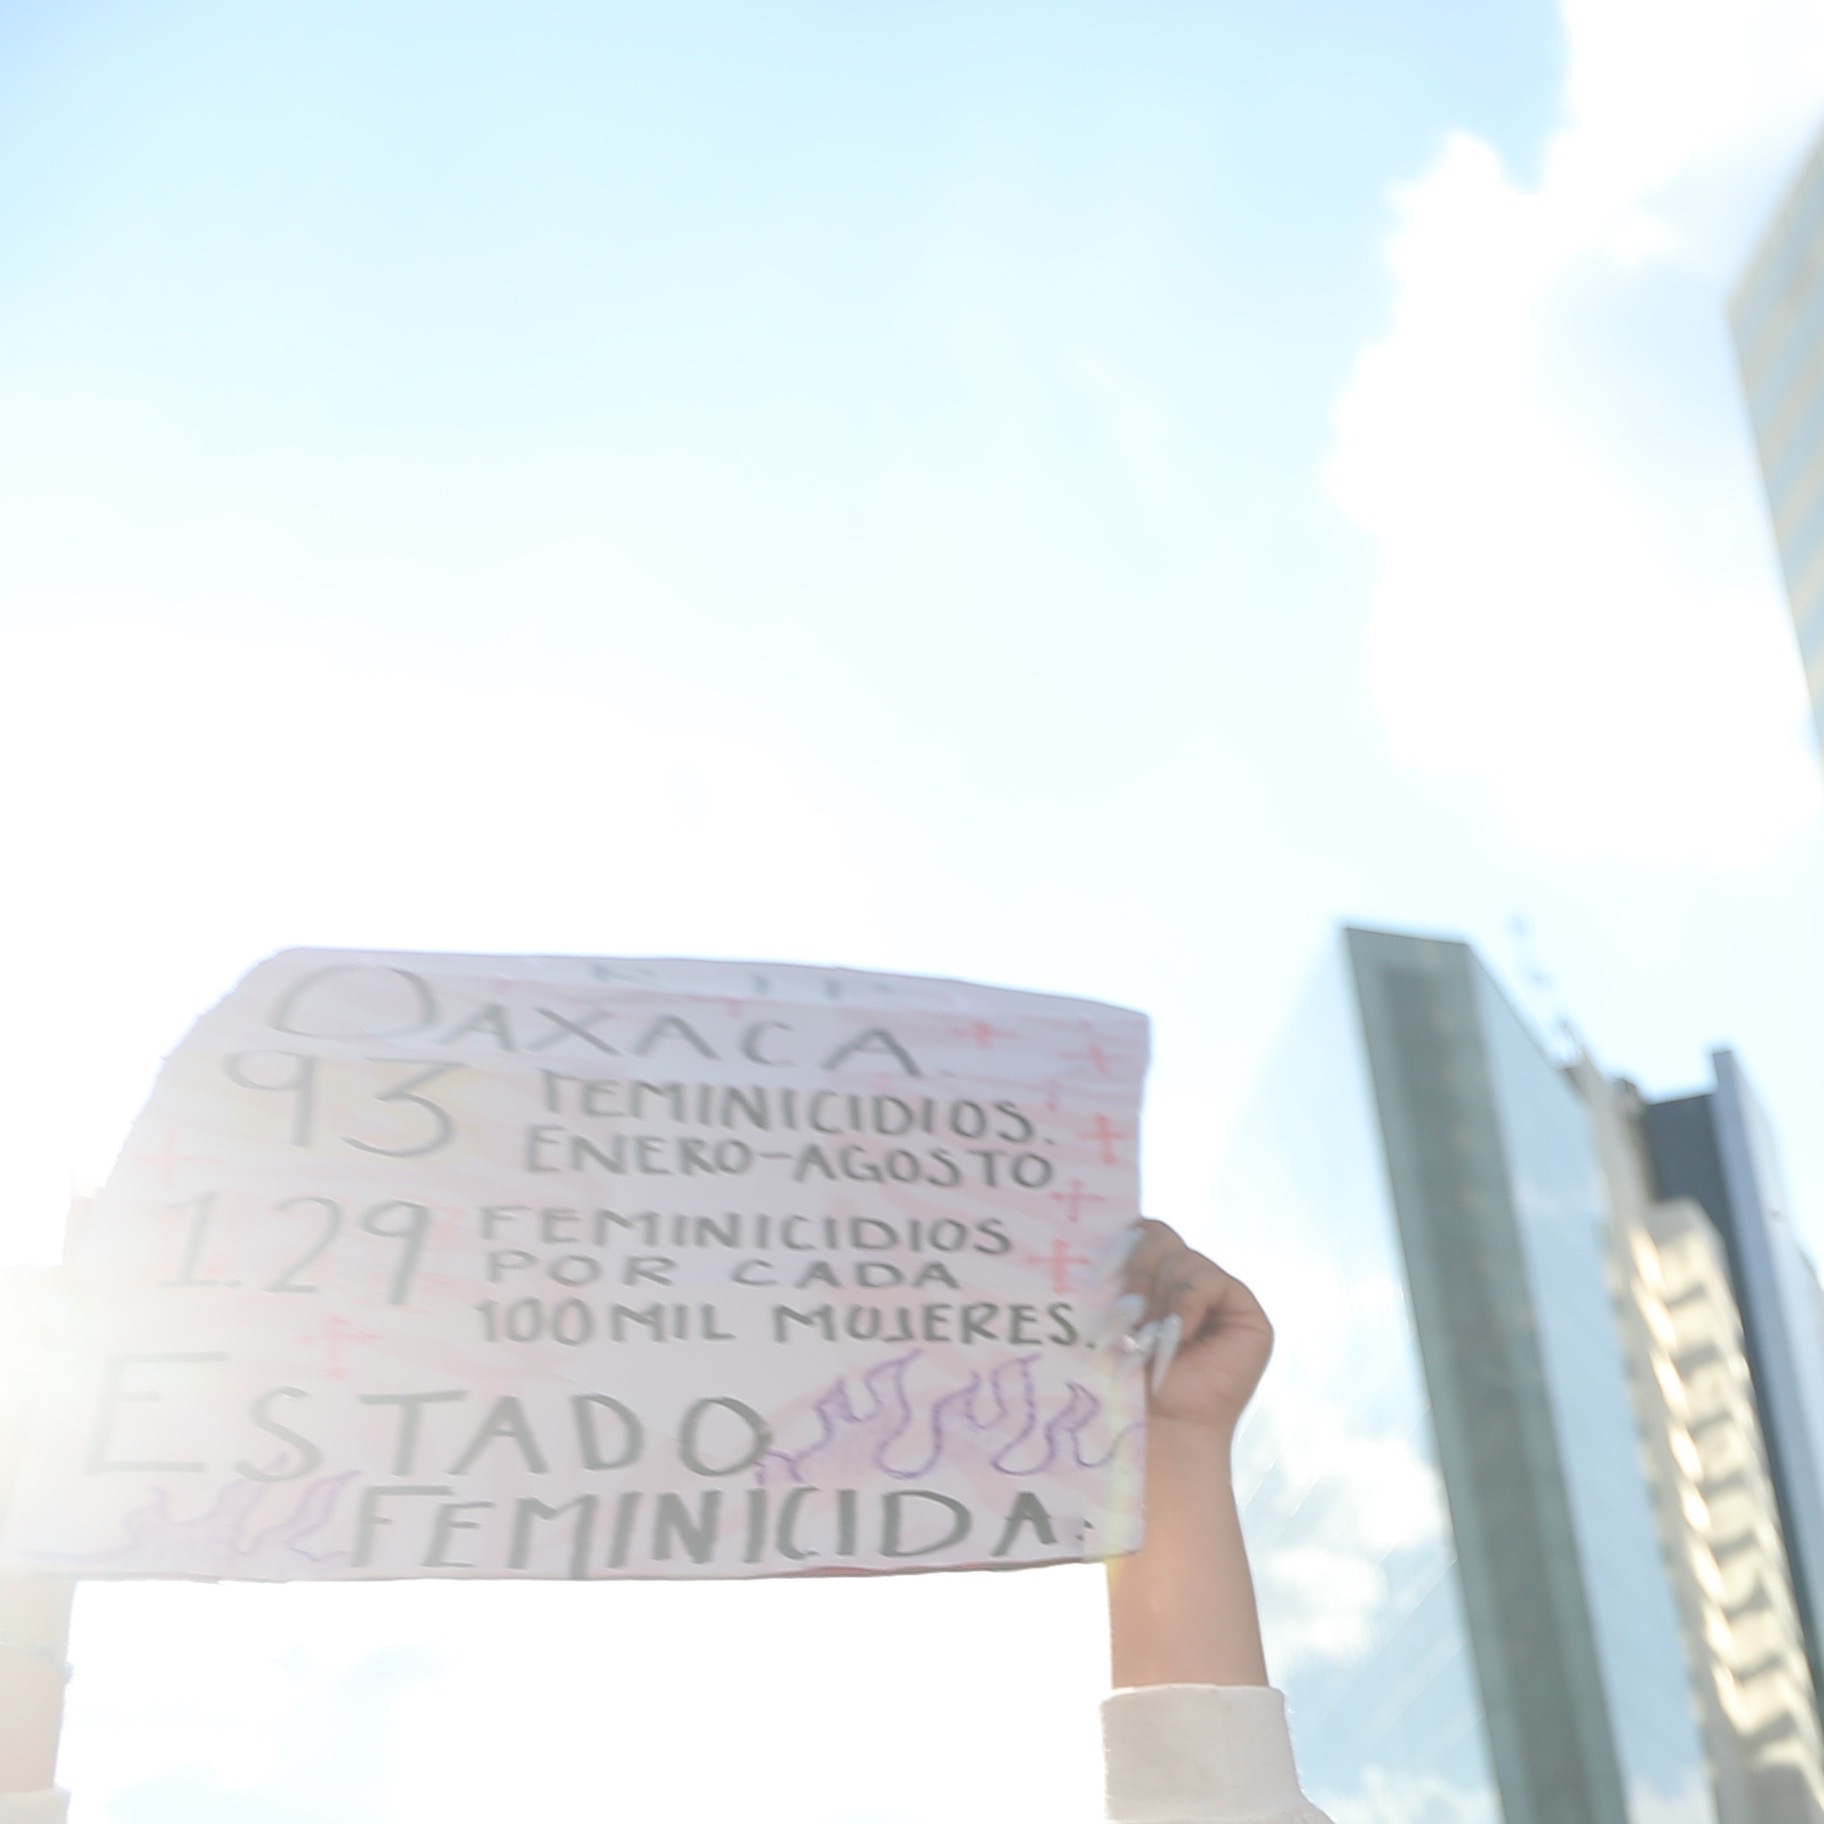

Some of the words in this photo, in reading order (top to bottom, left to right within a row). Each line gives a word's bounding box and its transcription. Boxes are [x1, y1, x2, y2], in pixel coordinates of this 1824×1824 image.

[222, 1048, 470, 1160] 93
[476, 1206, 1015, 1257] FEMINICIDIOS
[484, 1249, 678, 1288] POR
[730, 1258, 964, 1290] CADA
[82, 1352, 774, 1480] ESTADO
